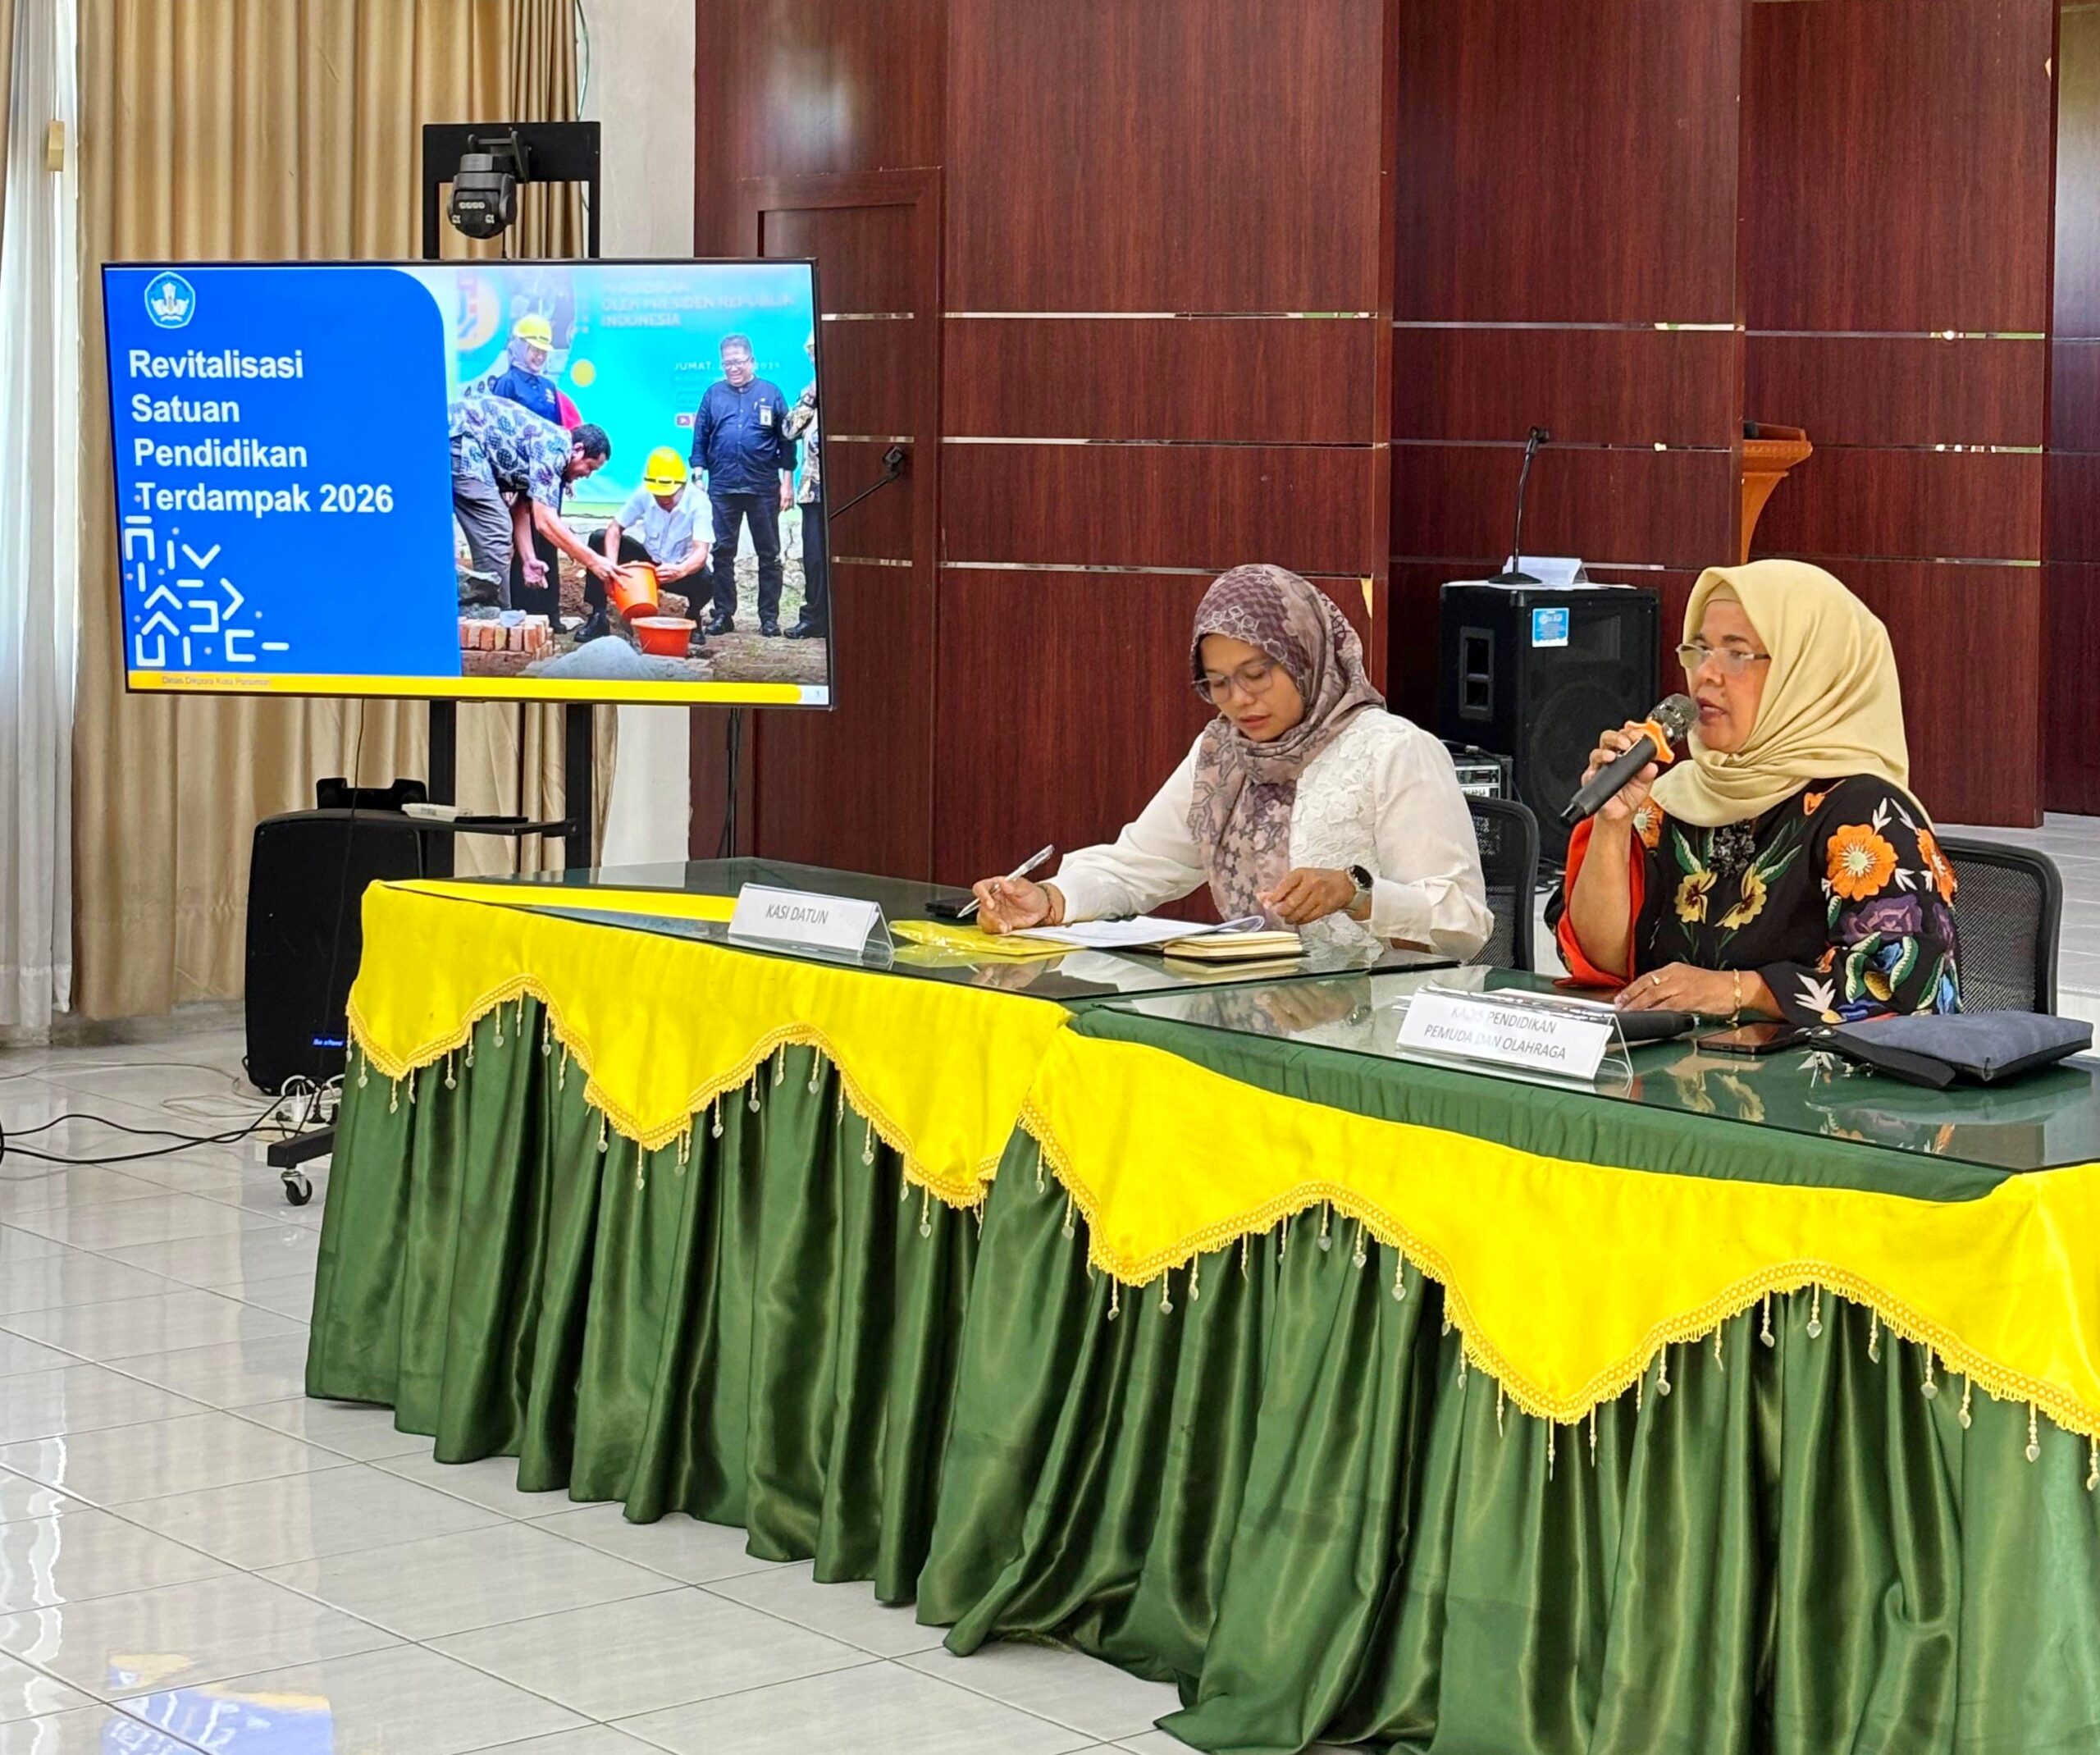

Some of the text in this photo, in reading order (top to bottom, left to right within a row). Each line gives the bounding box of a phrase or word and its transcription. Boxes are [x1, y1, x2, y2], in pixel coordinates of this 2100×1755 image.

[129, 350, 304, 378] Revitalisasi
[674, 361, 712, 371] JUMAT
[131, 394, 240, 423] Satuan
[134, 438, 308, 468] Pendidikan
[135, 482, 394, 519] Terdampak 2026
[765, 903, 829, 925] KASI DATUN
[1486, 1010, 1557, 1035] PENDIDIKAN
[1423, 1023, 1567, 1061] PEMUDA DAN OLAHRAGA
